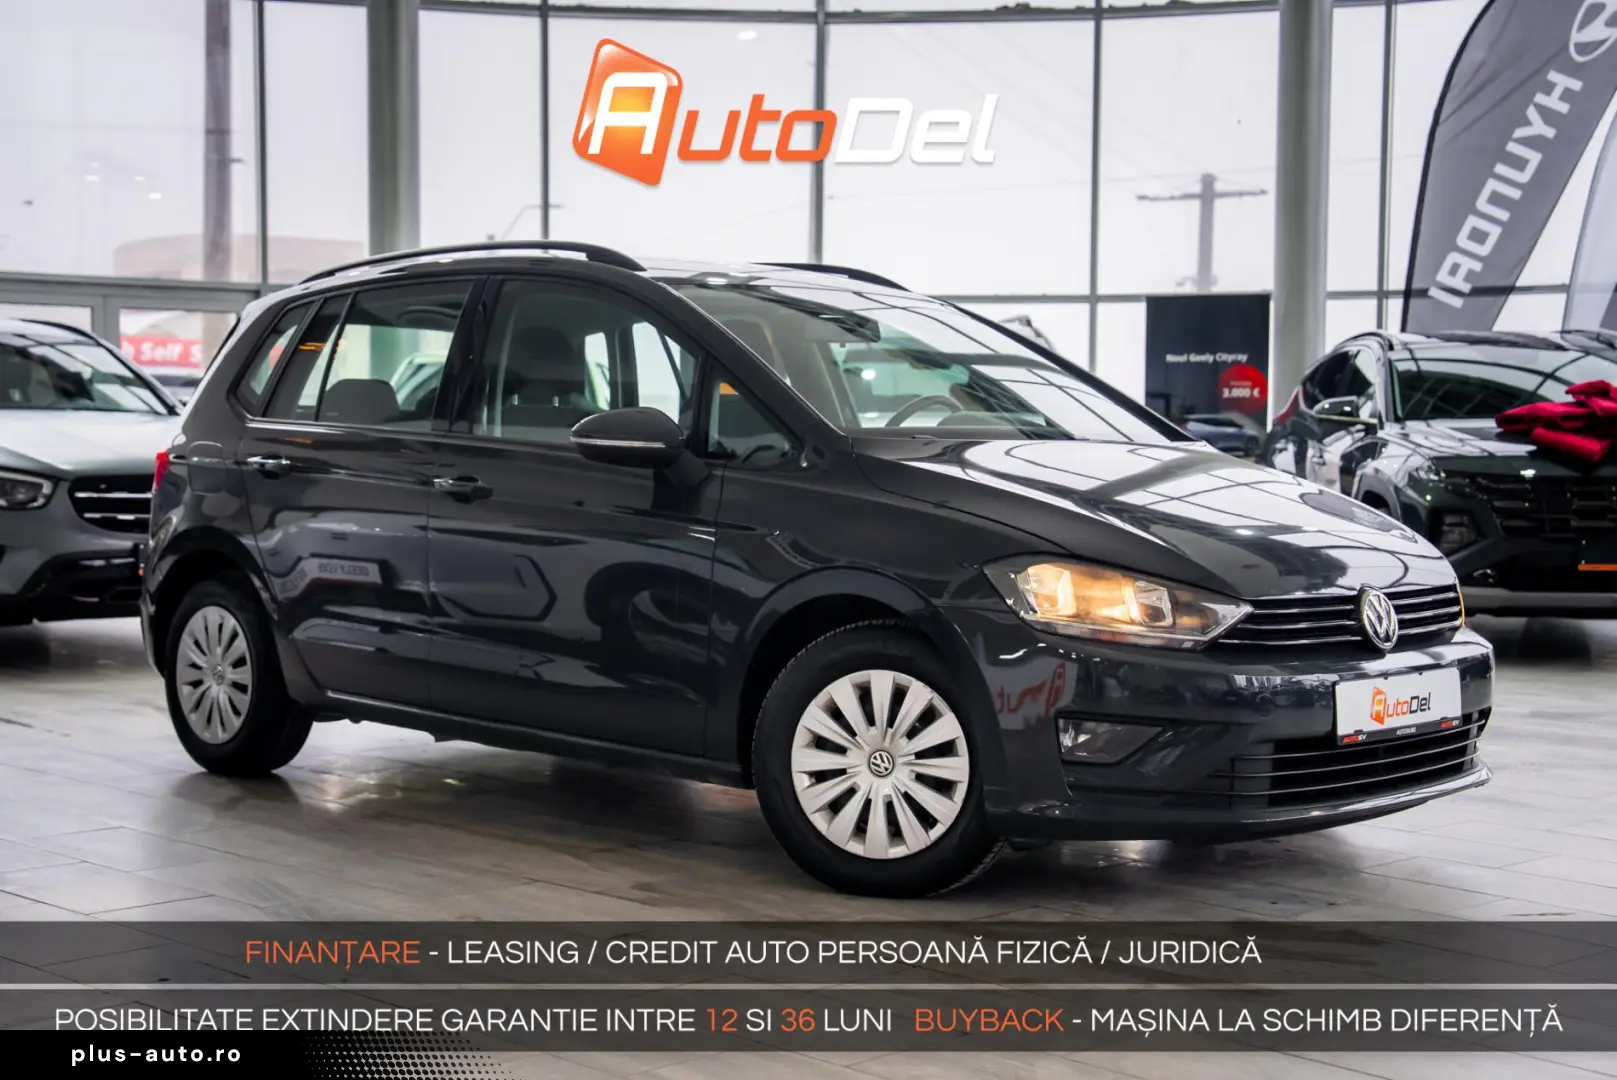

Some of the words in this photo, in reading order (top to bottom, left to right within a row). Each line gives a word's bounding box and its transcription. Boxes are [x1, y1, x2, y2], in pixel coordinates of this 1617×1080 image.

[140, 341, 184, 363] Self
[1189, 352, 1214, 364] Geely
[1370, 688, 1432, 721] AutoDel
